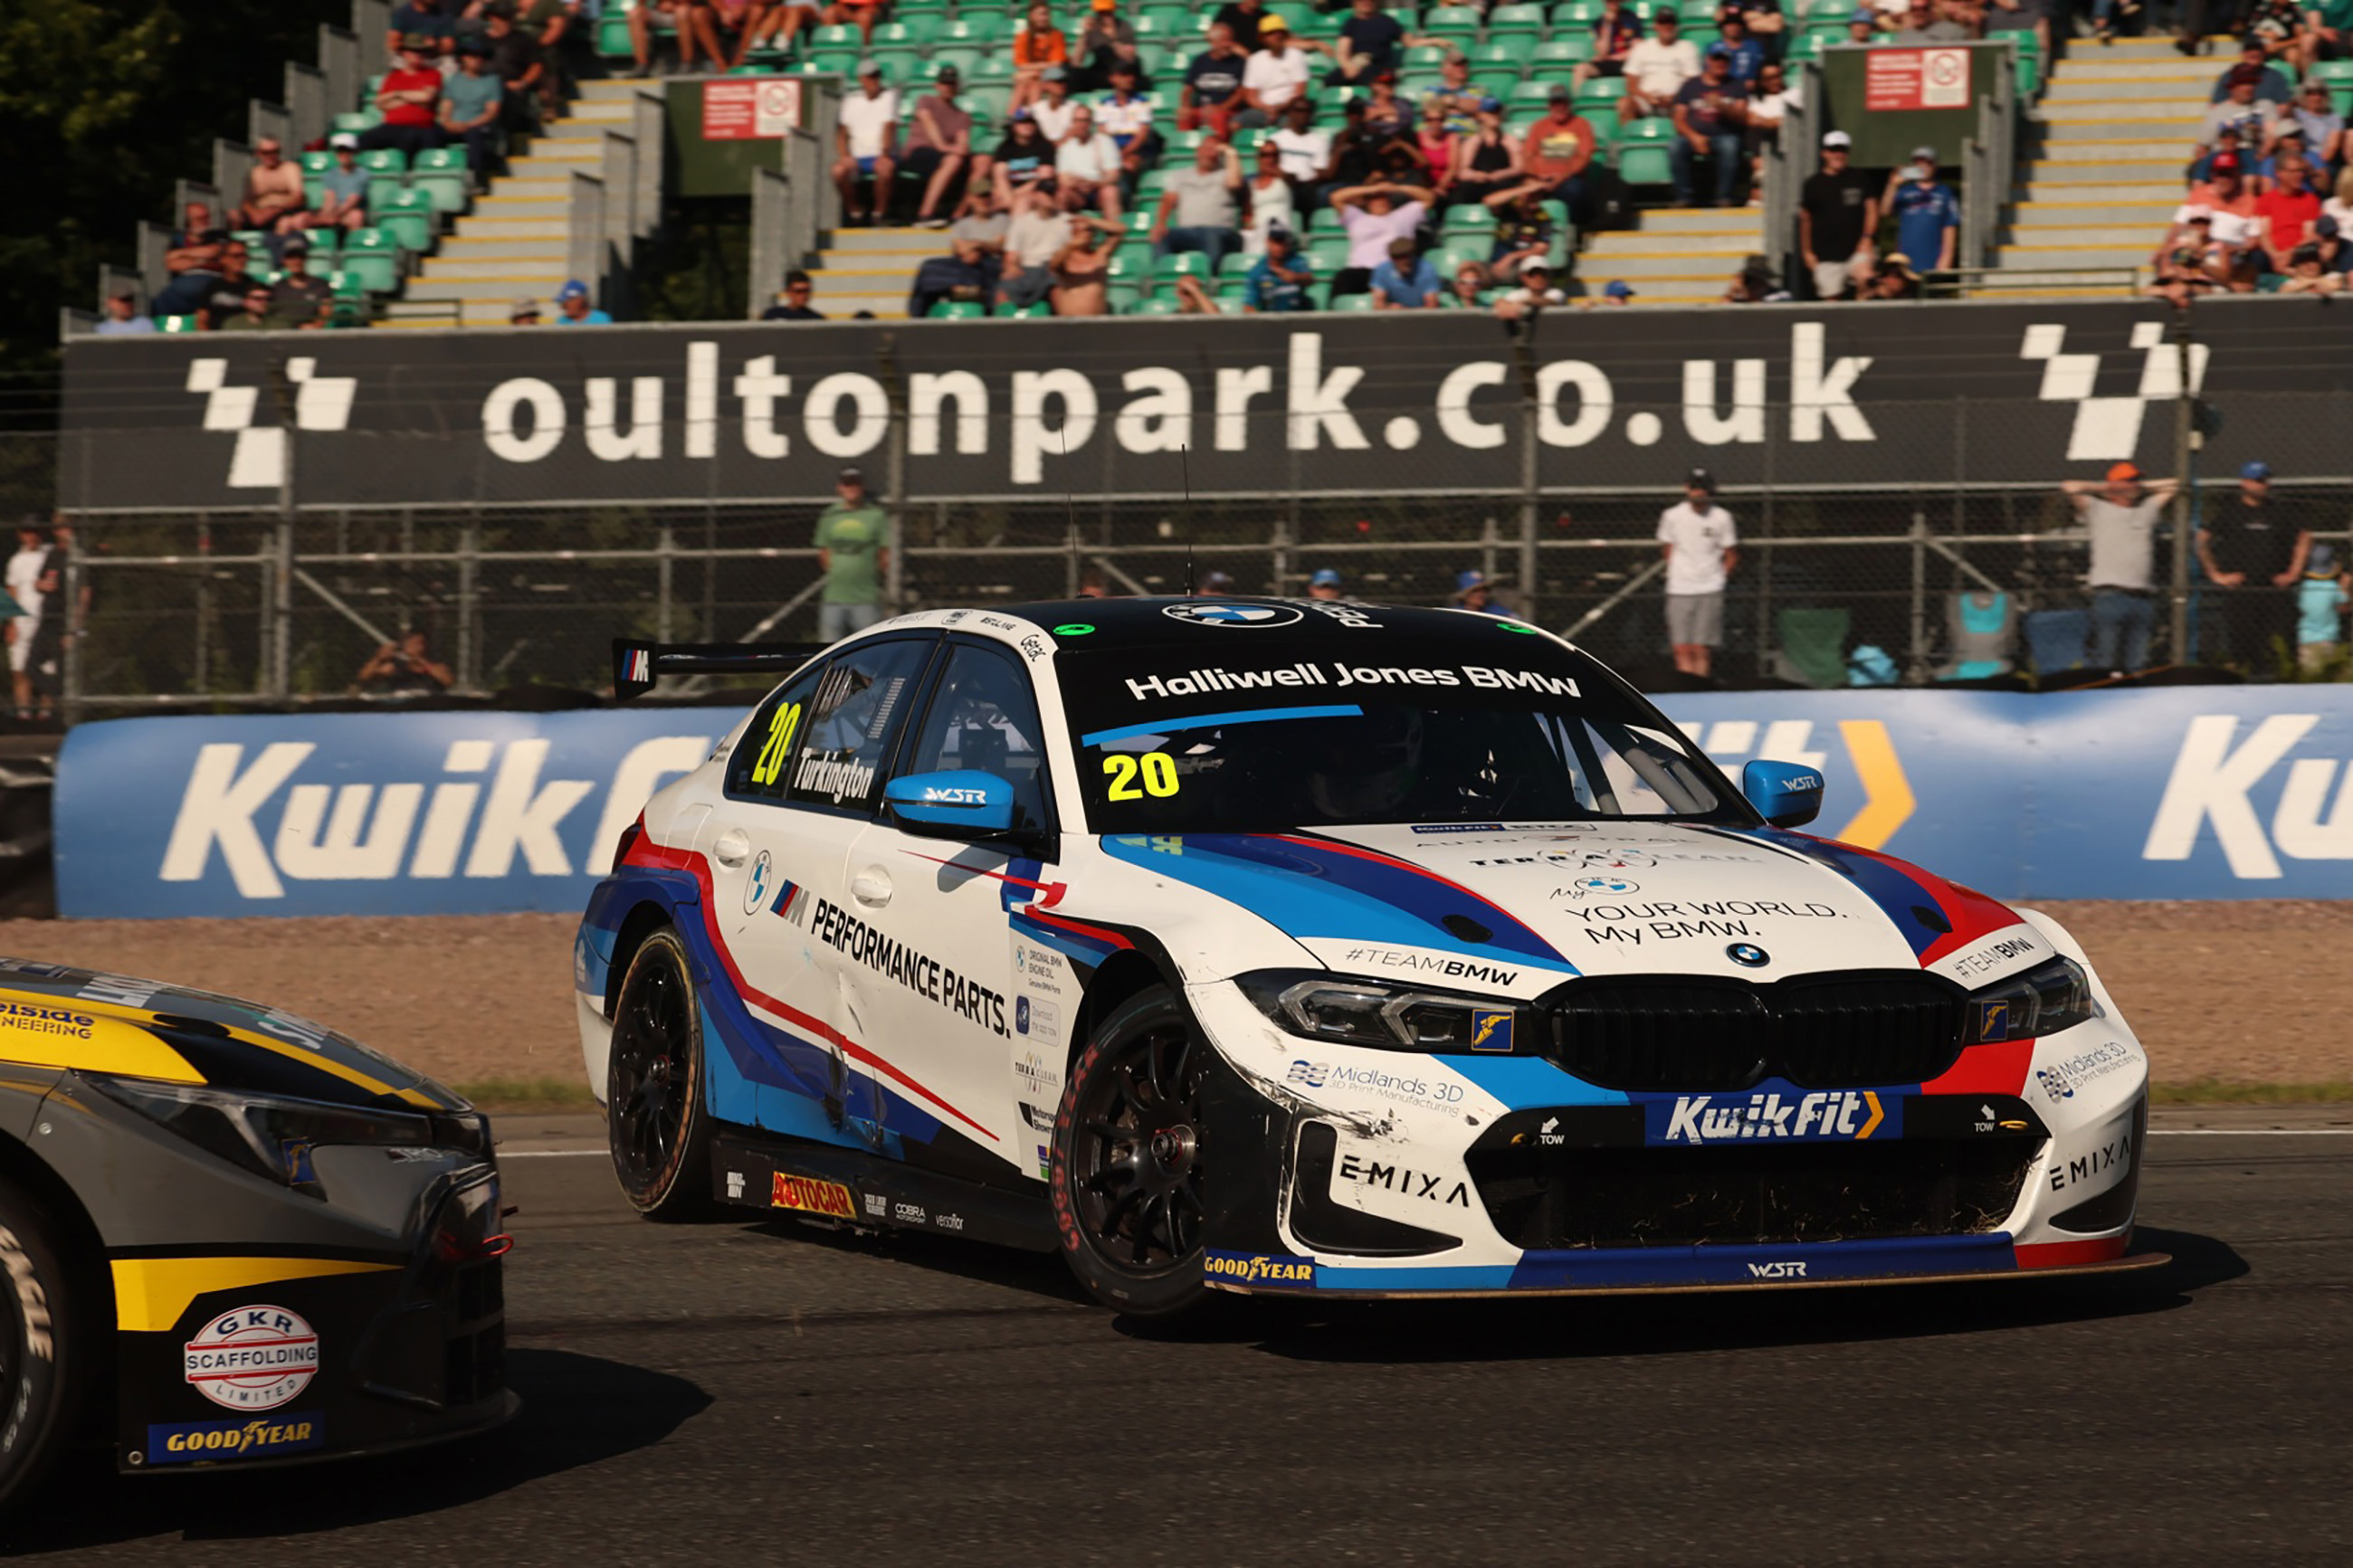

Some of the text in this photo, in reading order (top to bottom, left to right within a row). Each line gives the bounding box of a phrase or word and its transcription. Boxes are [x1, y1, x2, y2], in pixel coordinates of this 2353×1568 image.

[482, 322, 1877, 484] oultonpark.co.uk
[1125, 661, 1582, 700] Halliwell Jones BMW
[752, 701, 801, 785] 20
[794, 747, 874, 804] Turkington
[1102, 752, 1180, 802] 20
[1781, 775, 1817, 791] WSR
[925, 787, 986, 804] WSR
[1566, 900, 1848, 923] YOUR WORLD.
[1584, 919, 1762, 945] My BMW.
[811, 898, 940, 1003] PERFORMANCE
[944, 968, 1011, 1040] PARTS.
[1345, 948, 1518, 986] #TEAMBMW
[1954, 936, 2035, 979] #TEAMBMW
[2059, 1041, 2127, 1079] Midlands 3D
[1329, 1079, 1460, 1117] 3D Print Manufacturing
[1331, 1066, 1464, 1103] Midlands 3D
[1539, 1135, 1564, 1145] TOW
[1974, 1123, 1995, 1132] TOW
[771, 1172, 853, 1215] AUTOCAR
[1339, 1155, 1469, 1208] EMIXA
[895, 1202, 926, 1219] COBRA
[1205, 1256, 1312, 1280] GOODYEAR
[1748, 1261, 1807, 1278] WSR
[216, 1311, 293, 1335] GKR
[186, 1346, 317, 1370] SCAFFOLDING
[215, 1379, 297, 1402] LIMITED
[167, 1421, 312, 1452] GOODYEAR
